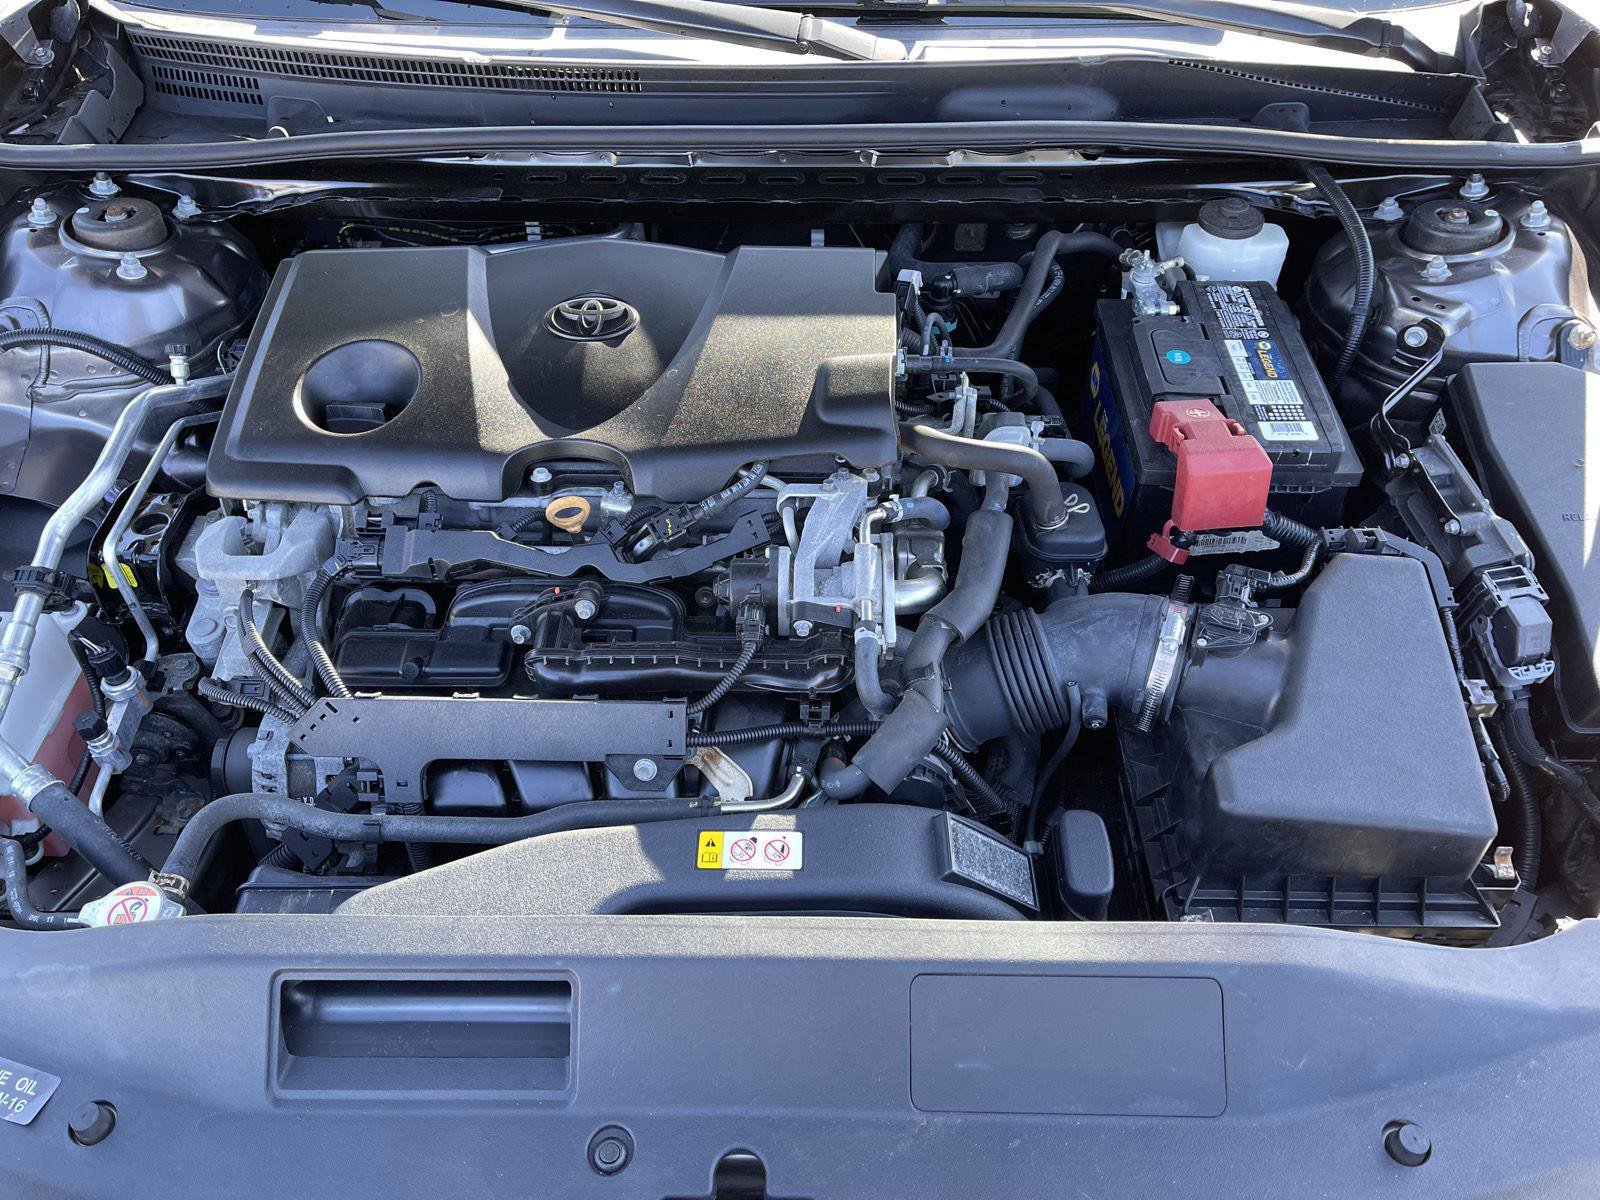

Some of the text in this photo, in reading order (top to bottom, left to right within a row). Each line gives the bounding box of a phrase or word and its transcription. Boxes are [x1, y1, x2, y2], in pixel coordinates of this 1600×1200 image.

[1257, 349, 1278, 378] LEGEND
[1093, 402, 1124, 518] LEGEND
[0, 1070, 38, 1096] E OIL
